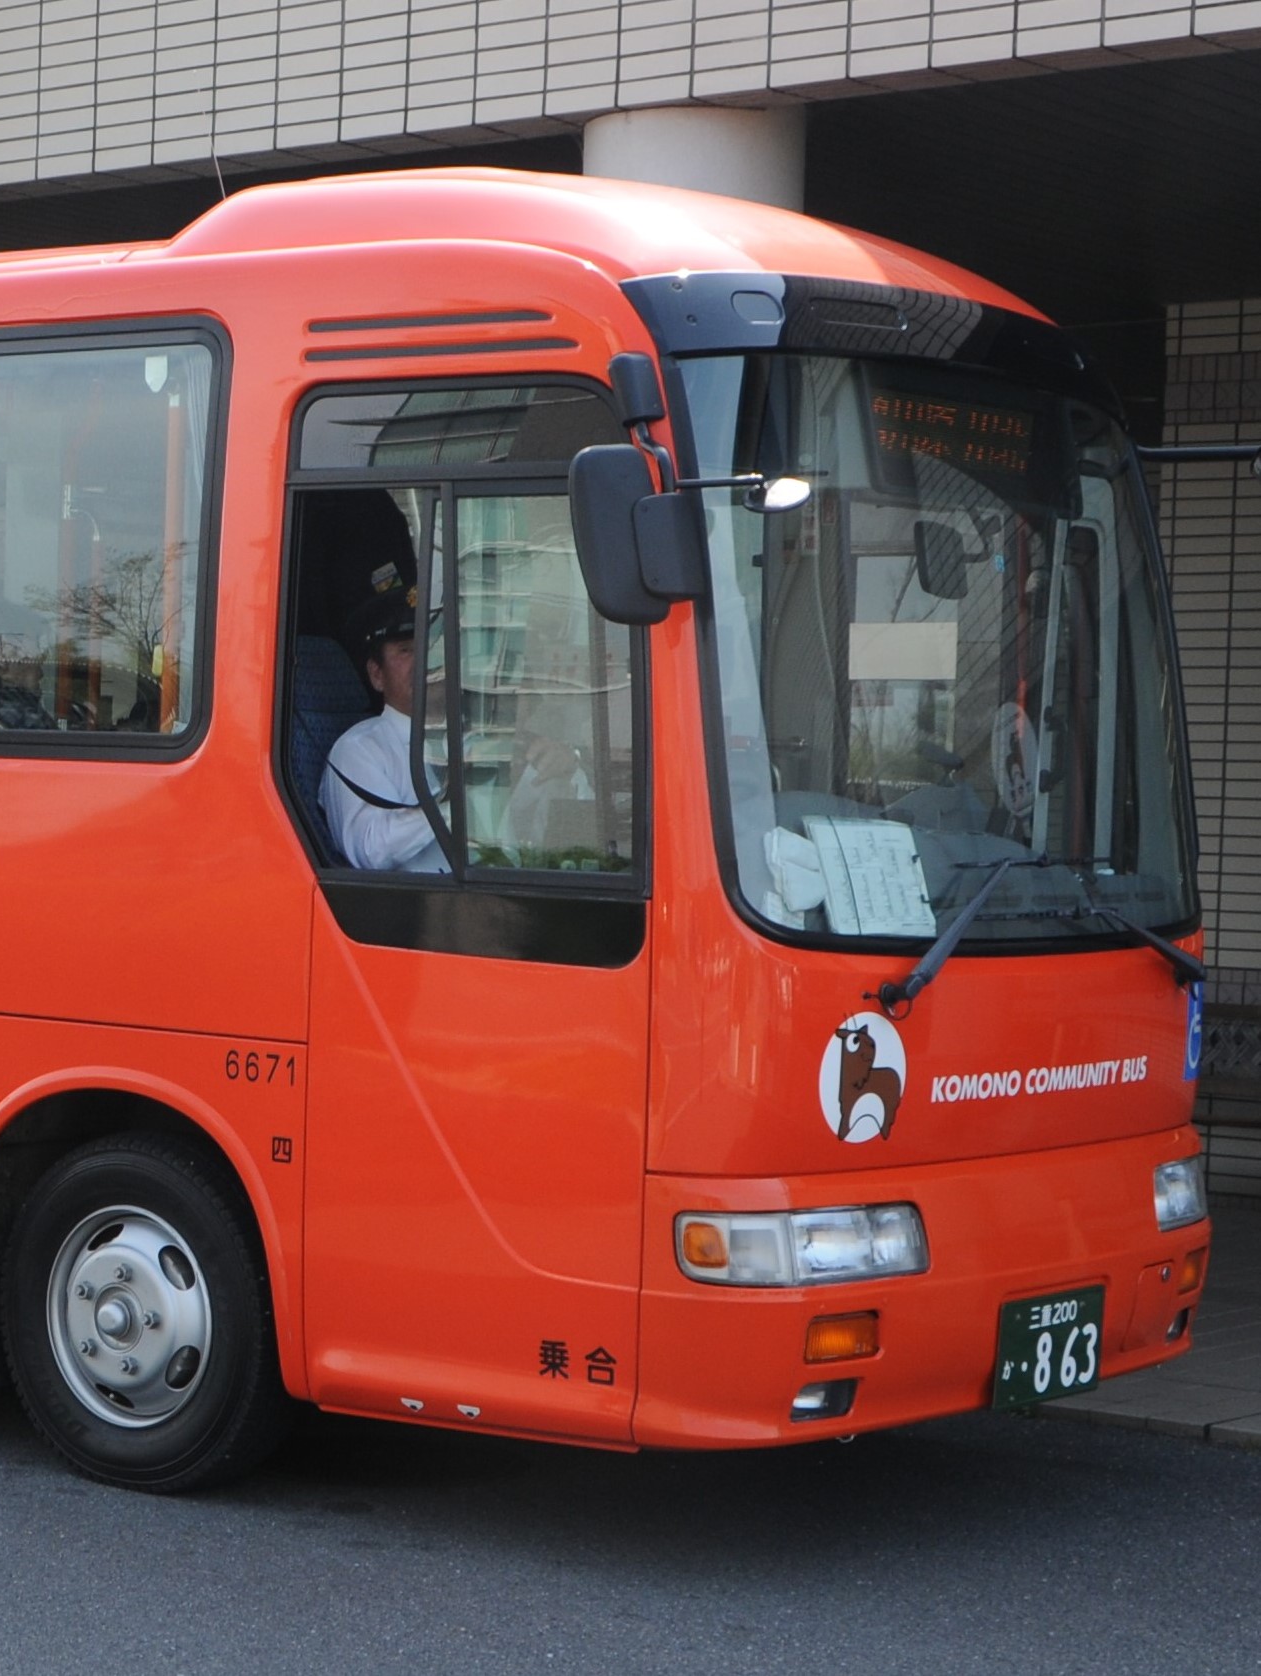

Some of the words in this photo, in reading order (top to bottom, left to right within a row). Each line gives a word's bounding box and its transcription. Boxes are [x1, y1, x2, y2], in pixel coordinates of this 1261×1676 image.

[225, 1049, 295, 1087] 6671
[931, 1070, 1021, 1103] KOMONO
[1025, 1060, 1120, 1094] COMMUNITY
[1121, 1056, 1148, 1084] BUS
[271, 1136, 292, 1164] 四
[539, 1340, 617, 1386] 乗合
